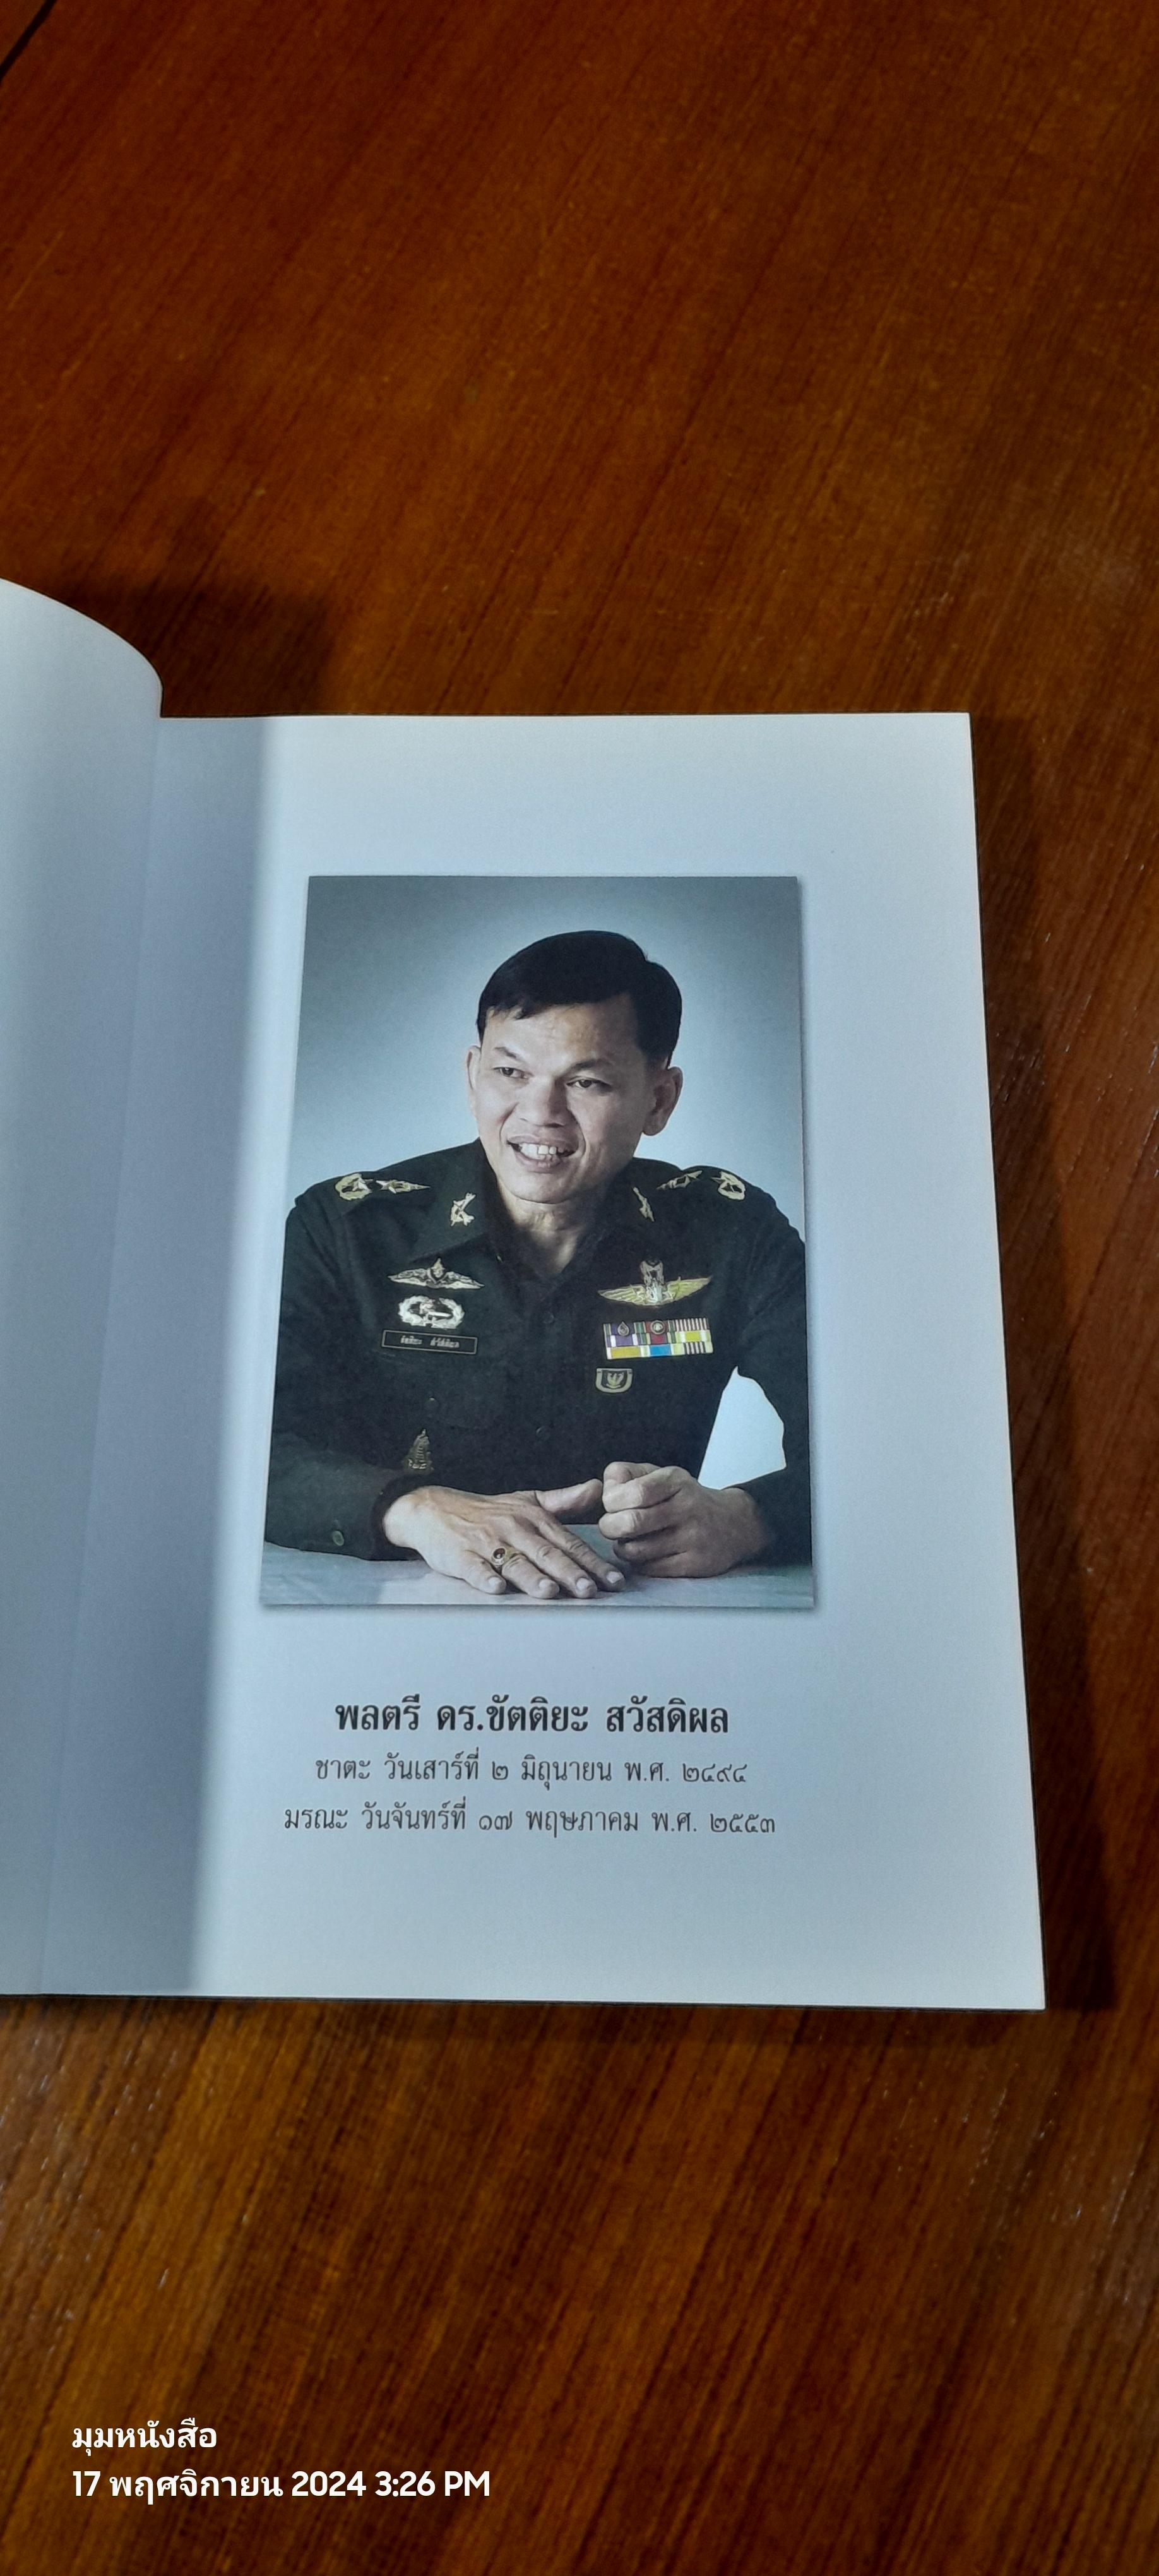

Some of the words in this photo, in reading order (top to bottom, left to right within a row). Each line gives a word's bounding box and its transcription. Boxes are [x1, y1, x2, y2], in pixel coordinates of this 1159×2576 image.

[335, 1694, 421, 1731] พลตรี
[436, 1695, 588, 1732] ดร.ขัตติยะ
[607, 1695, 728, 1733] สวัสดิผล
[315, 1760, 371, 1780] ชาตะ
[384, 1746, 479, 1780] วันเสาร์ที่
[492, 1761, 509, 1780] ๒
[521, 1754, 612, 1791] มิถุนายน
[624, 1762, 669, 1782] พ.ศ.
[682, 1763, 748, 1783] ๒๔๙๔
[285, 1810, 348, 1829] มรณะ
[362, 1796, 467, 1830] วันจันทร์ที่
[479, 1811, 513, 1831] ๑๗
[526, 1811, 638, 1839] พฤษภาคม
[651, 1813, 697, 1832] พ.ศ.
[710, 1813, 775, 1834] ๒๕๕๓
